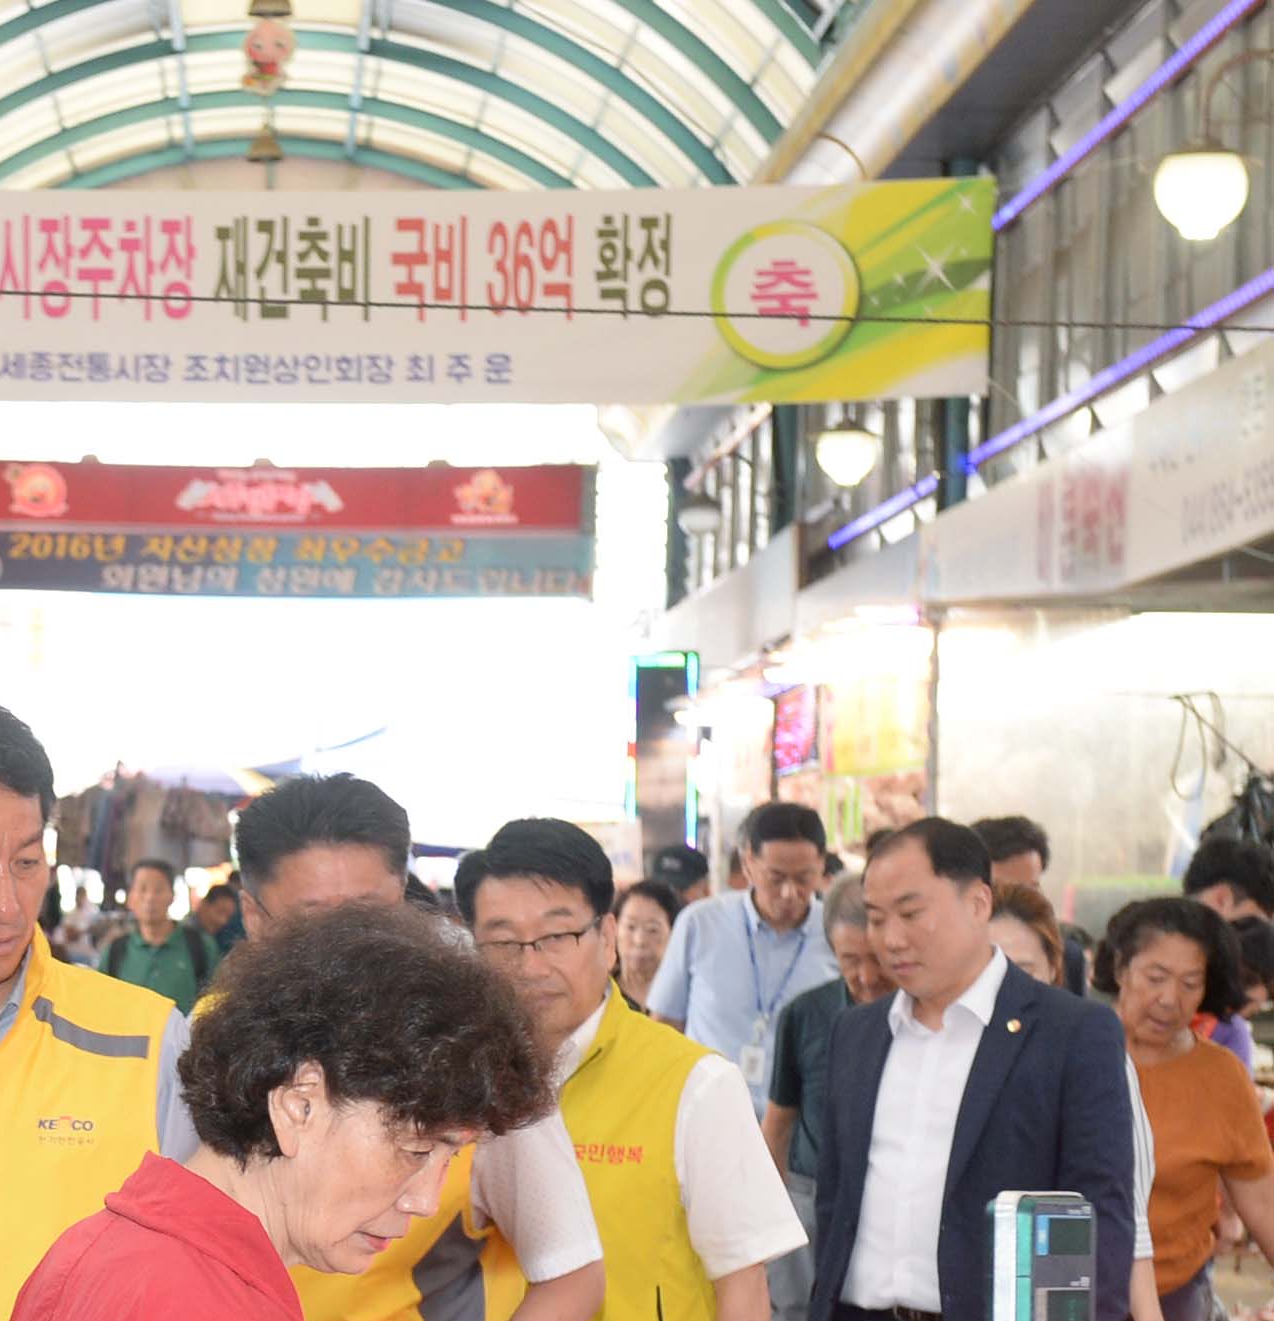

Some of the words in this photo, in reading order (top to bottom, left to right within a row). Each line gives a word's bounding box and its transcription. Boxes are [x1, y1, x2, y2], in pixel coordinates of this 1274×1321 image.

[213, 214, 371, 322] 재건축비
[390, 214, 469, 322] 국비
[486, 213, 576, 321] 36억
[596, 212, 673, 319] 확정
[750, 259, 819, 327] 축
[183, 351, 395, 386] 조치원상인회장
